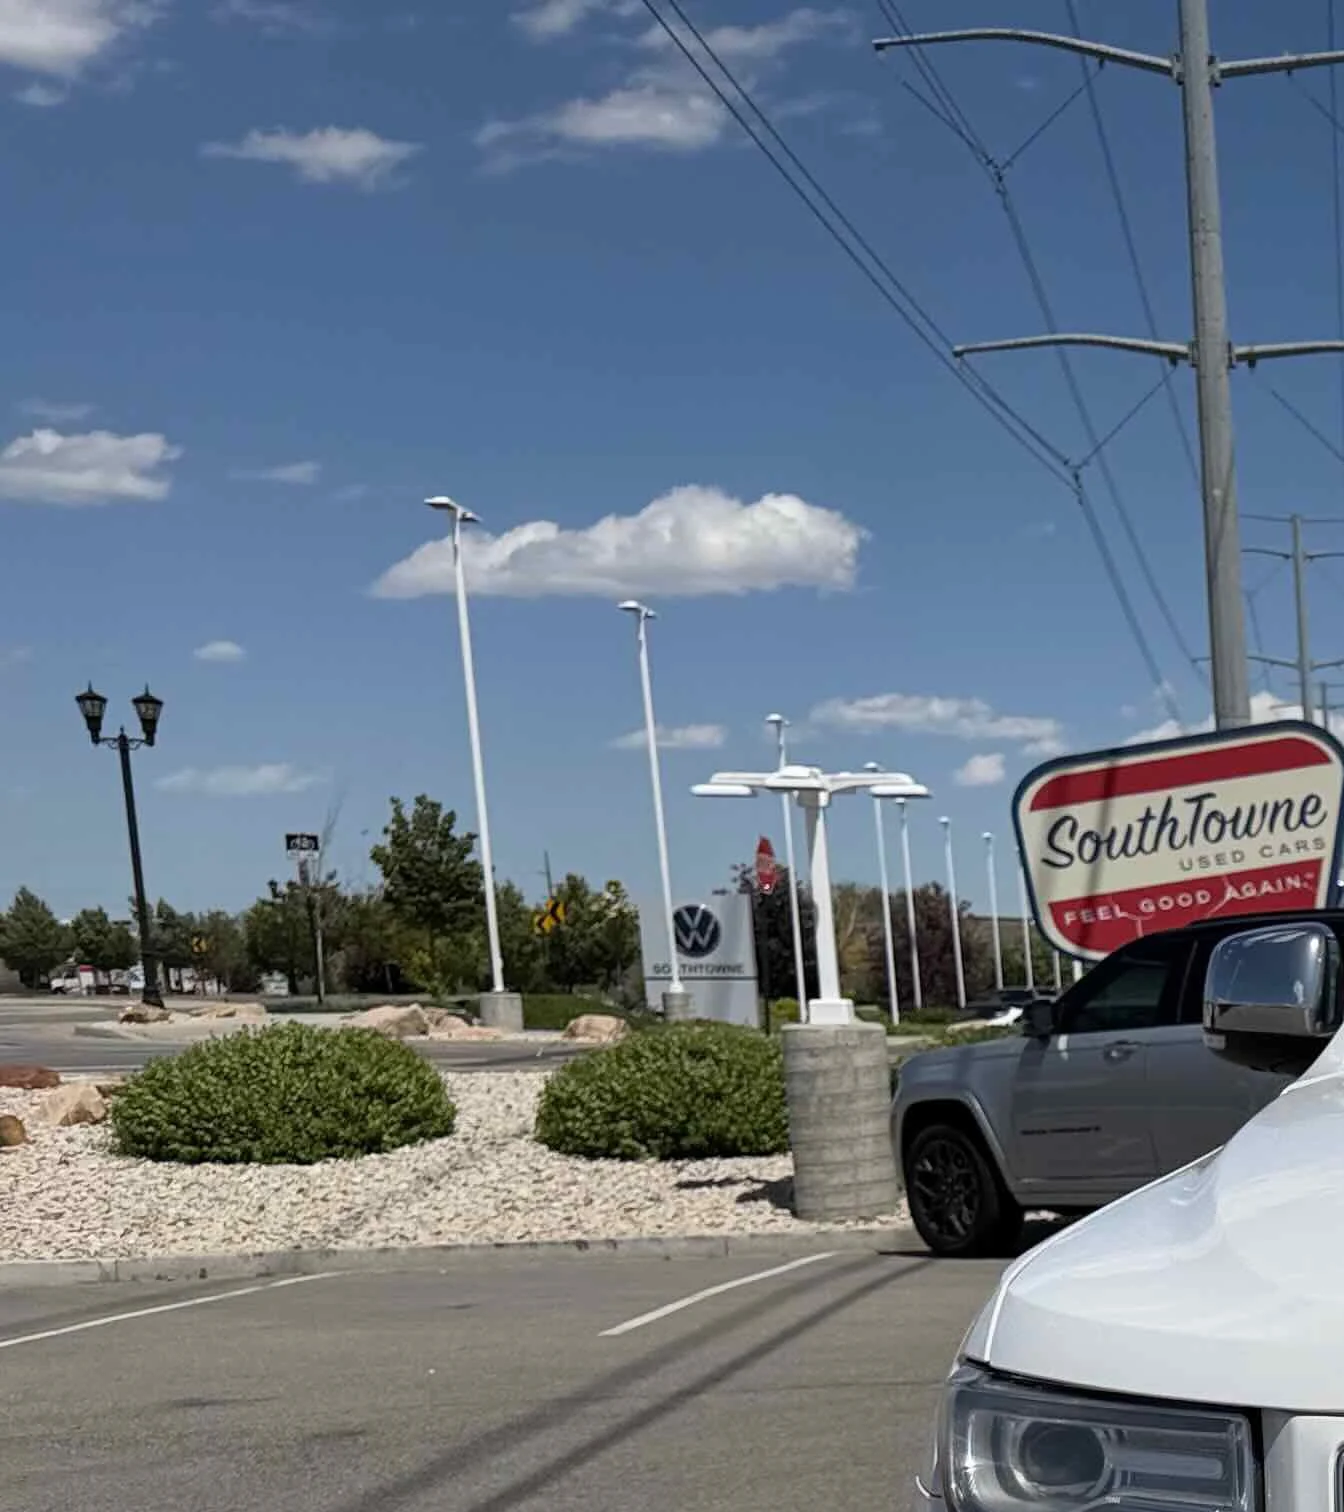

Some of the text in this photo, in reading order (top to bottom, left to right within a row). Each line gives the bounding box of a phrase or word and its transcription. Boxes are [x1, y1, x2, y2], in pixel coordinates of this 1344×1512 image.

[1041, 792, 1328, 869] SouthTowne
[1178, 837, 1326, 872] USED CARS
[1063, 904, 1128, 928] FEEL
[1139, 889, 1212, 914] GOOD
[653, 962, 745, 975] SOTHTOWNE
